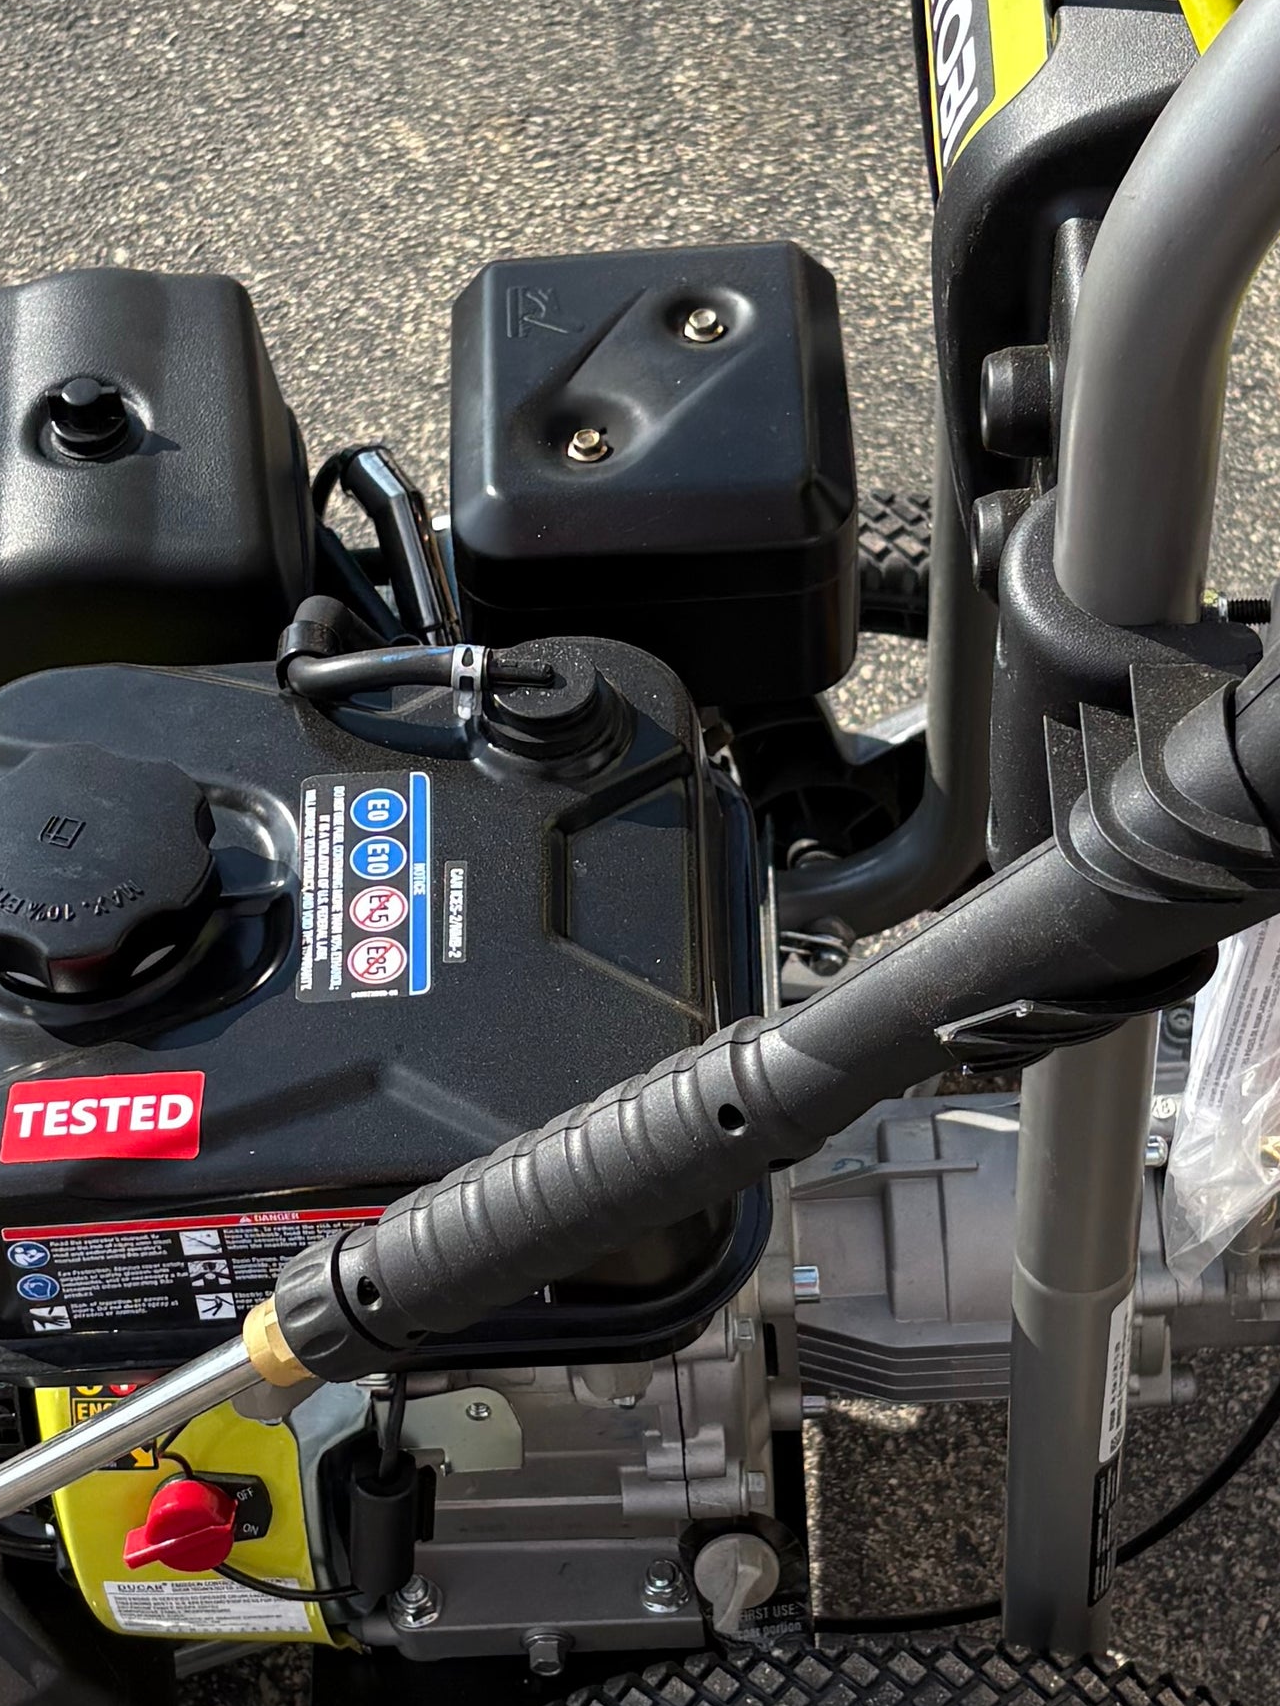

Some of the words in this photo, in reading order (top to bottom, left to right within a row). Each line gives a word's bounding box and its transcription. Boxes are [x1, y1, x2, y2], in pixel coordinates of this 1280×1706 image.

[367, 799, 390, 821] E0
[367, 844, 390, 874] E10
[413, 862, 427, 896] NOTICE
[28, 900, 77, 922] 10%
[82, 880, 145, 916] MAX.
[368, 894, 389, 923] E15
[366, 946, 388, 975] E85
[13, 1094, 194, 1139] TESTED
[254, 1212, 300, 1222] DANGER
[236, 1487, 253, 1502] OFF
[243, 1523, 259, 1536] ON
